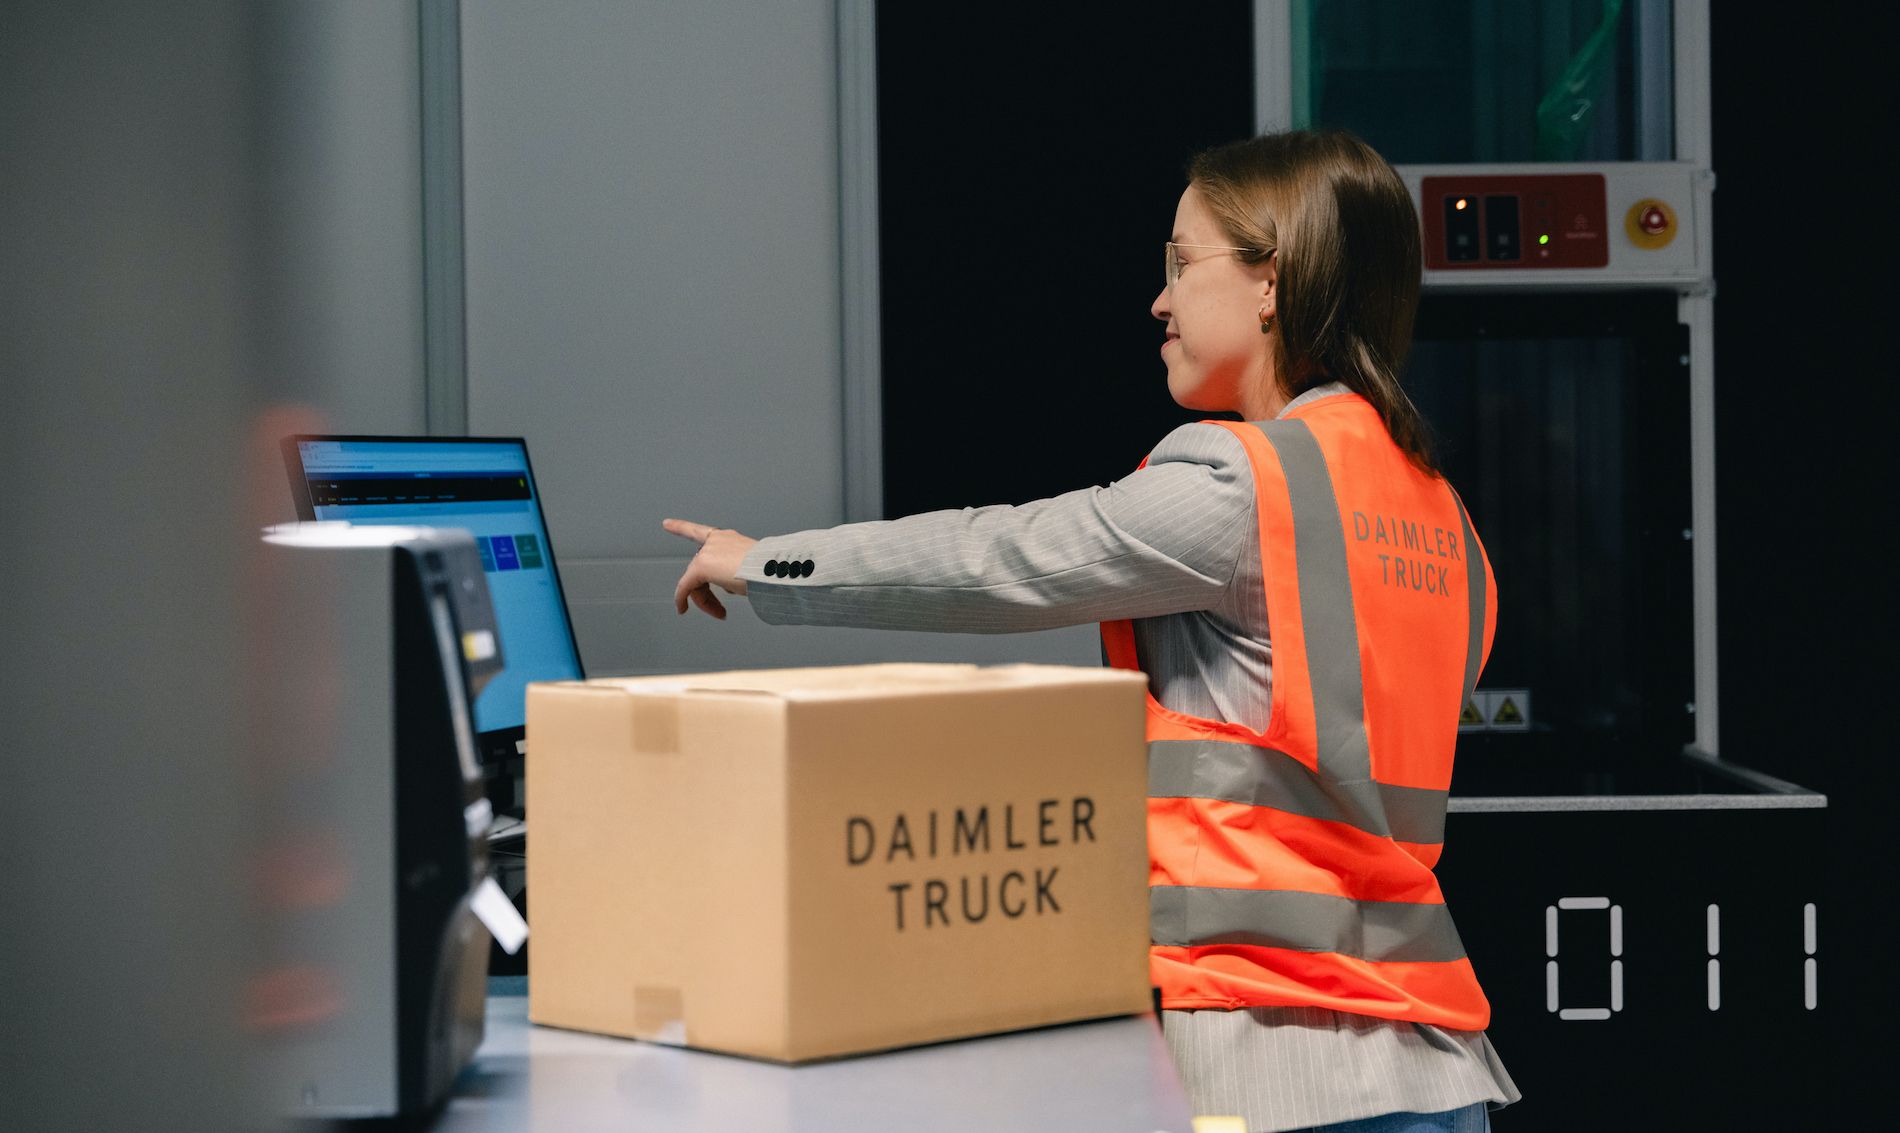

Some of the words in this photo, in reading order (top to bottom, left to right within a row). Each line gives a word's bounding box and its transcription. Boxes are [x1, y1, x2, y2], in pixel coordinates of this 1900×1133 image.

[1353, 511, 1461, 561] DAIMLER
[1378, 555, 1450, 597] TRUCK
[846, 796, 1096, 867] DAIMLER
[888, 866, 1062, 932] TRUCK
